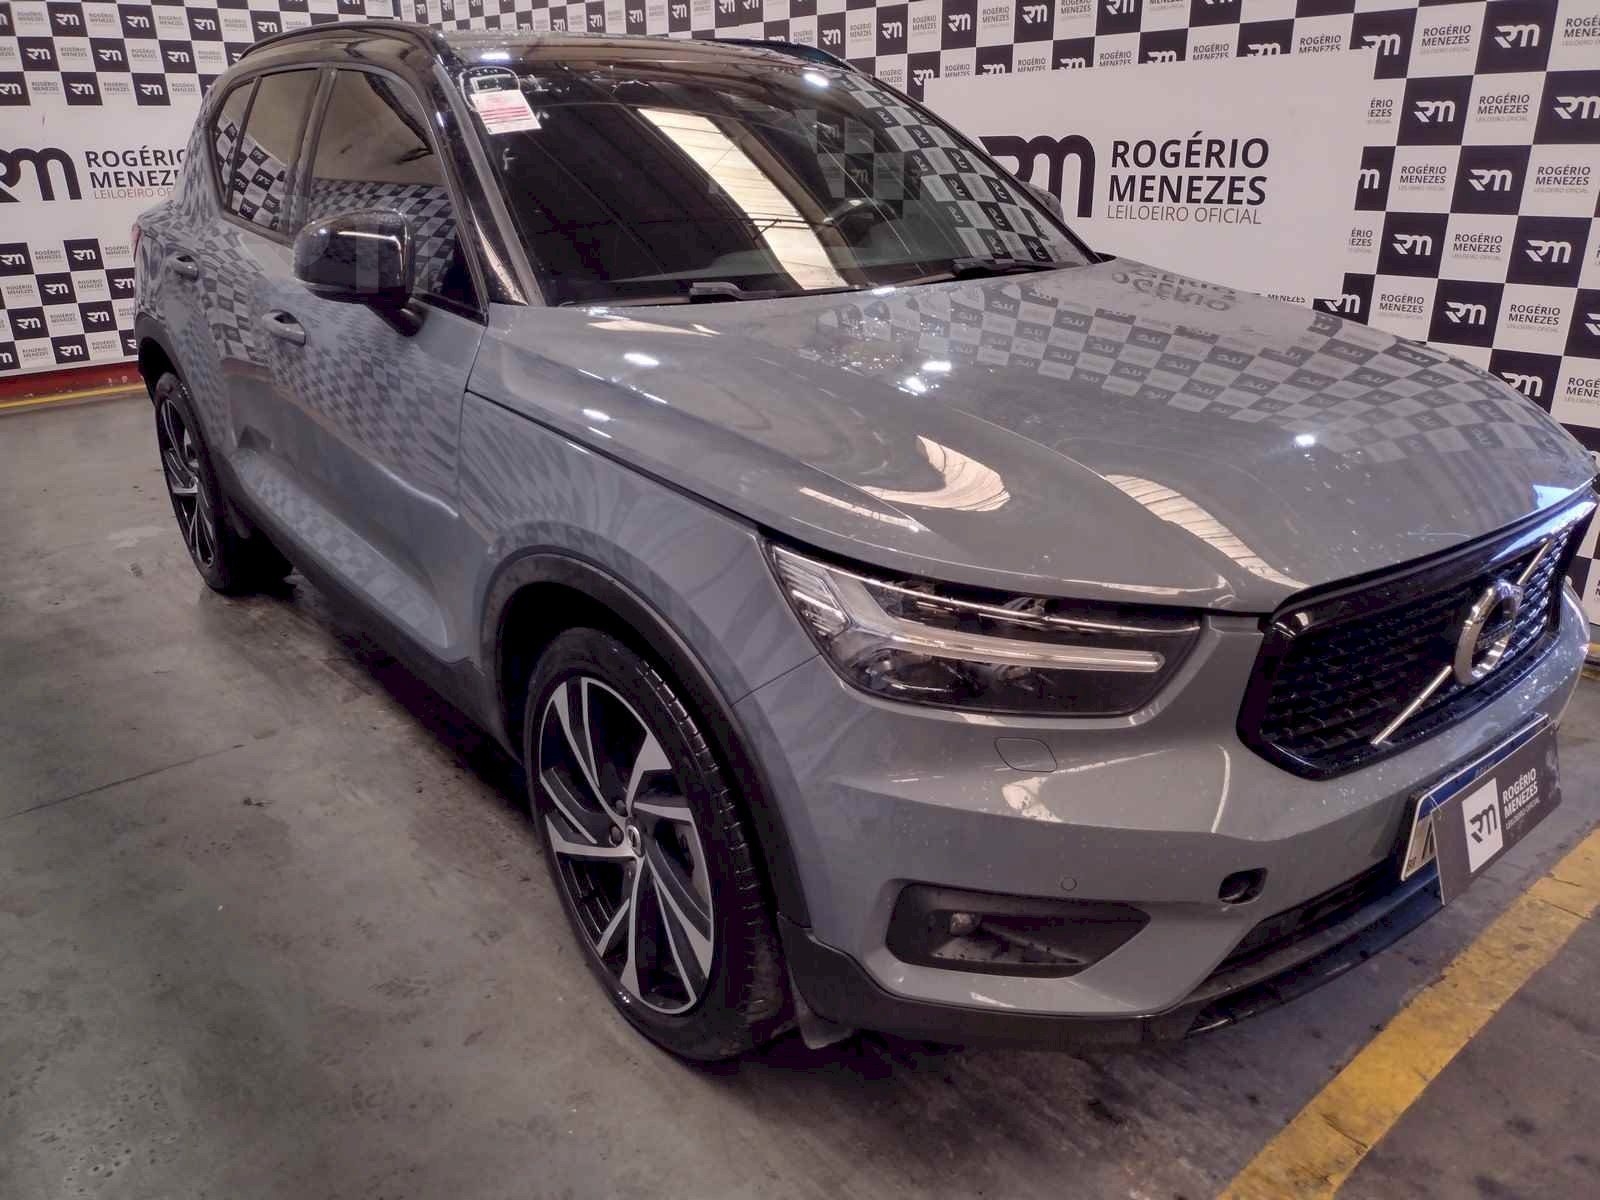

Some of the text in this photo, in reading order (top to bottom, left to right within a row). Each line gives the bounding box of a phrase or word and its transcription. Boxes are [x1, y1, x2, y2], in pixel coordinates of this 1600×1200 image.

[1565, 14, 1600, 27] ROGÉ
[1423, 24, 1472, 38] ROGÉRIO
[1563, 28, 1600, 38] MENE
[1300, 33, 1342, 46] ROGÉRIO
[1421, 35, 1471, 47] MENEZES
[1193, 42, 1230, 53] ROGÉRIO
[1099, 50, 1132, 60] ROGÉRIO
[1479, 92, 1530, 105] ROGÉRIO
[1477, 104, 1529, 115] MENEZES
[1111, 131, 1270, 170] ROGÉRIO
[1401, 163, 1447, 175] ROGÉRIO
[1537, 164, 1591, 176] ROGÉRIO
[1399, 174, 1446, 185] MENEZES
[1535, 176, 1590, 186] MENEZES
[94, 187, 154, 200] LEILOEIRO
[1108, 174, 1268, 206] MENEZES
[1106, 205, 1263, 225] LEILOEIRO OFICIAL
[1454, 232, 1503, 244] ROGÉRIO
[1453, 243, 1502, 254] MENEZES
[1380, 292, 1425, 305] ROGÉRIO
[1379, 302, 1424, 314] MENEZES
[1510, 303, 1561, 316] ROGÉRIO
[1508, 313, 1560, 326] MENEZES
[1502, 767, 1537, 804] ROGÉRIO
[1504, 781, 1538, 819] MENEZES
